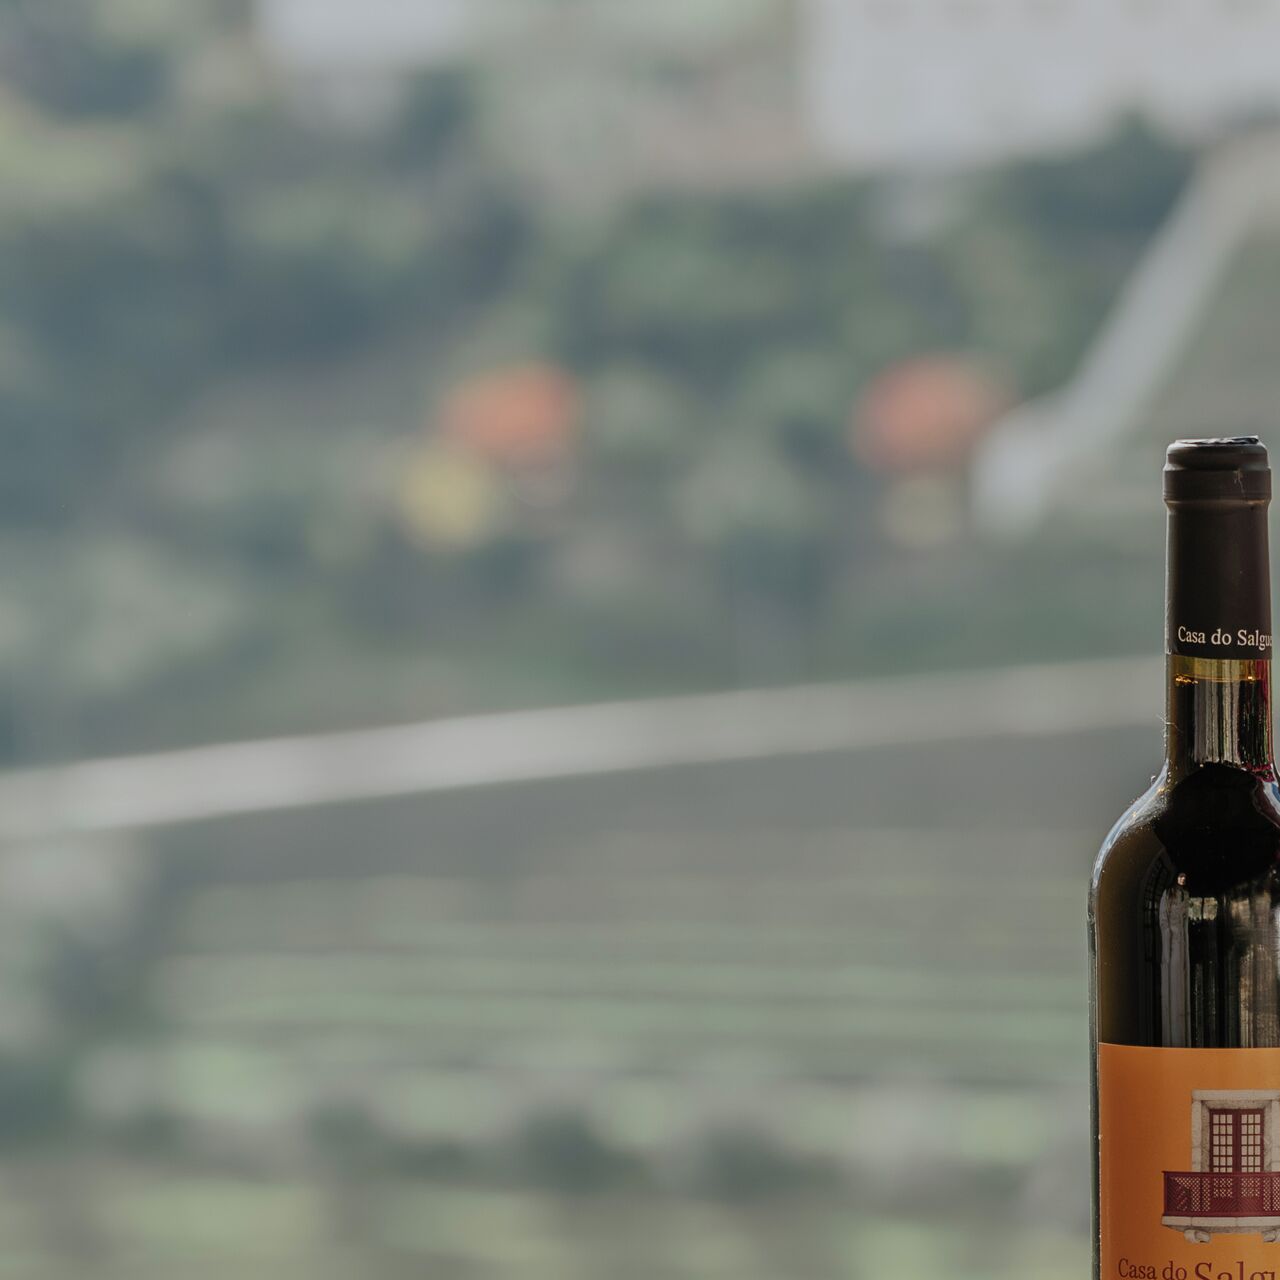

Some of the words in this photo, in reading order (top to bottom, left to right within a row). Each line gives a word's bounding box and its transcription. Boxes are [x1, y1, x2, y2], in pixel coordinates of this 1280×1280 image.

[1178, 626, 1206, 644] Casa
[1211, 628, 1232, 646] do
[1118, 1258, 1157, 1280] Casa
